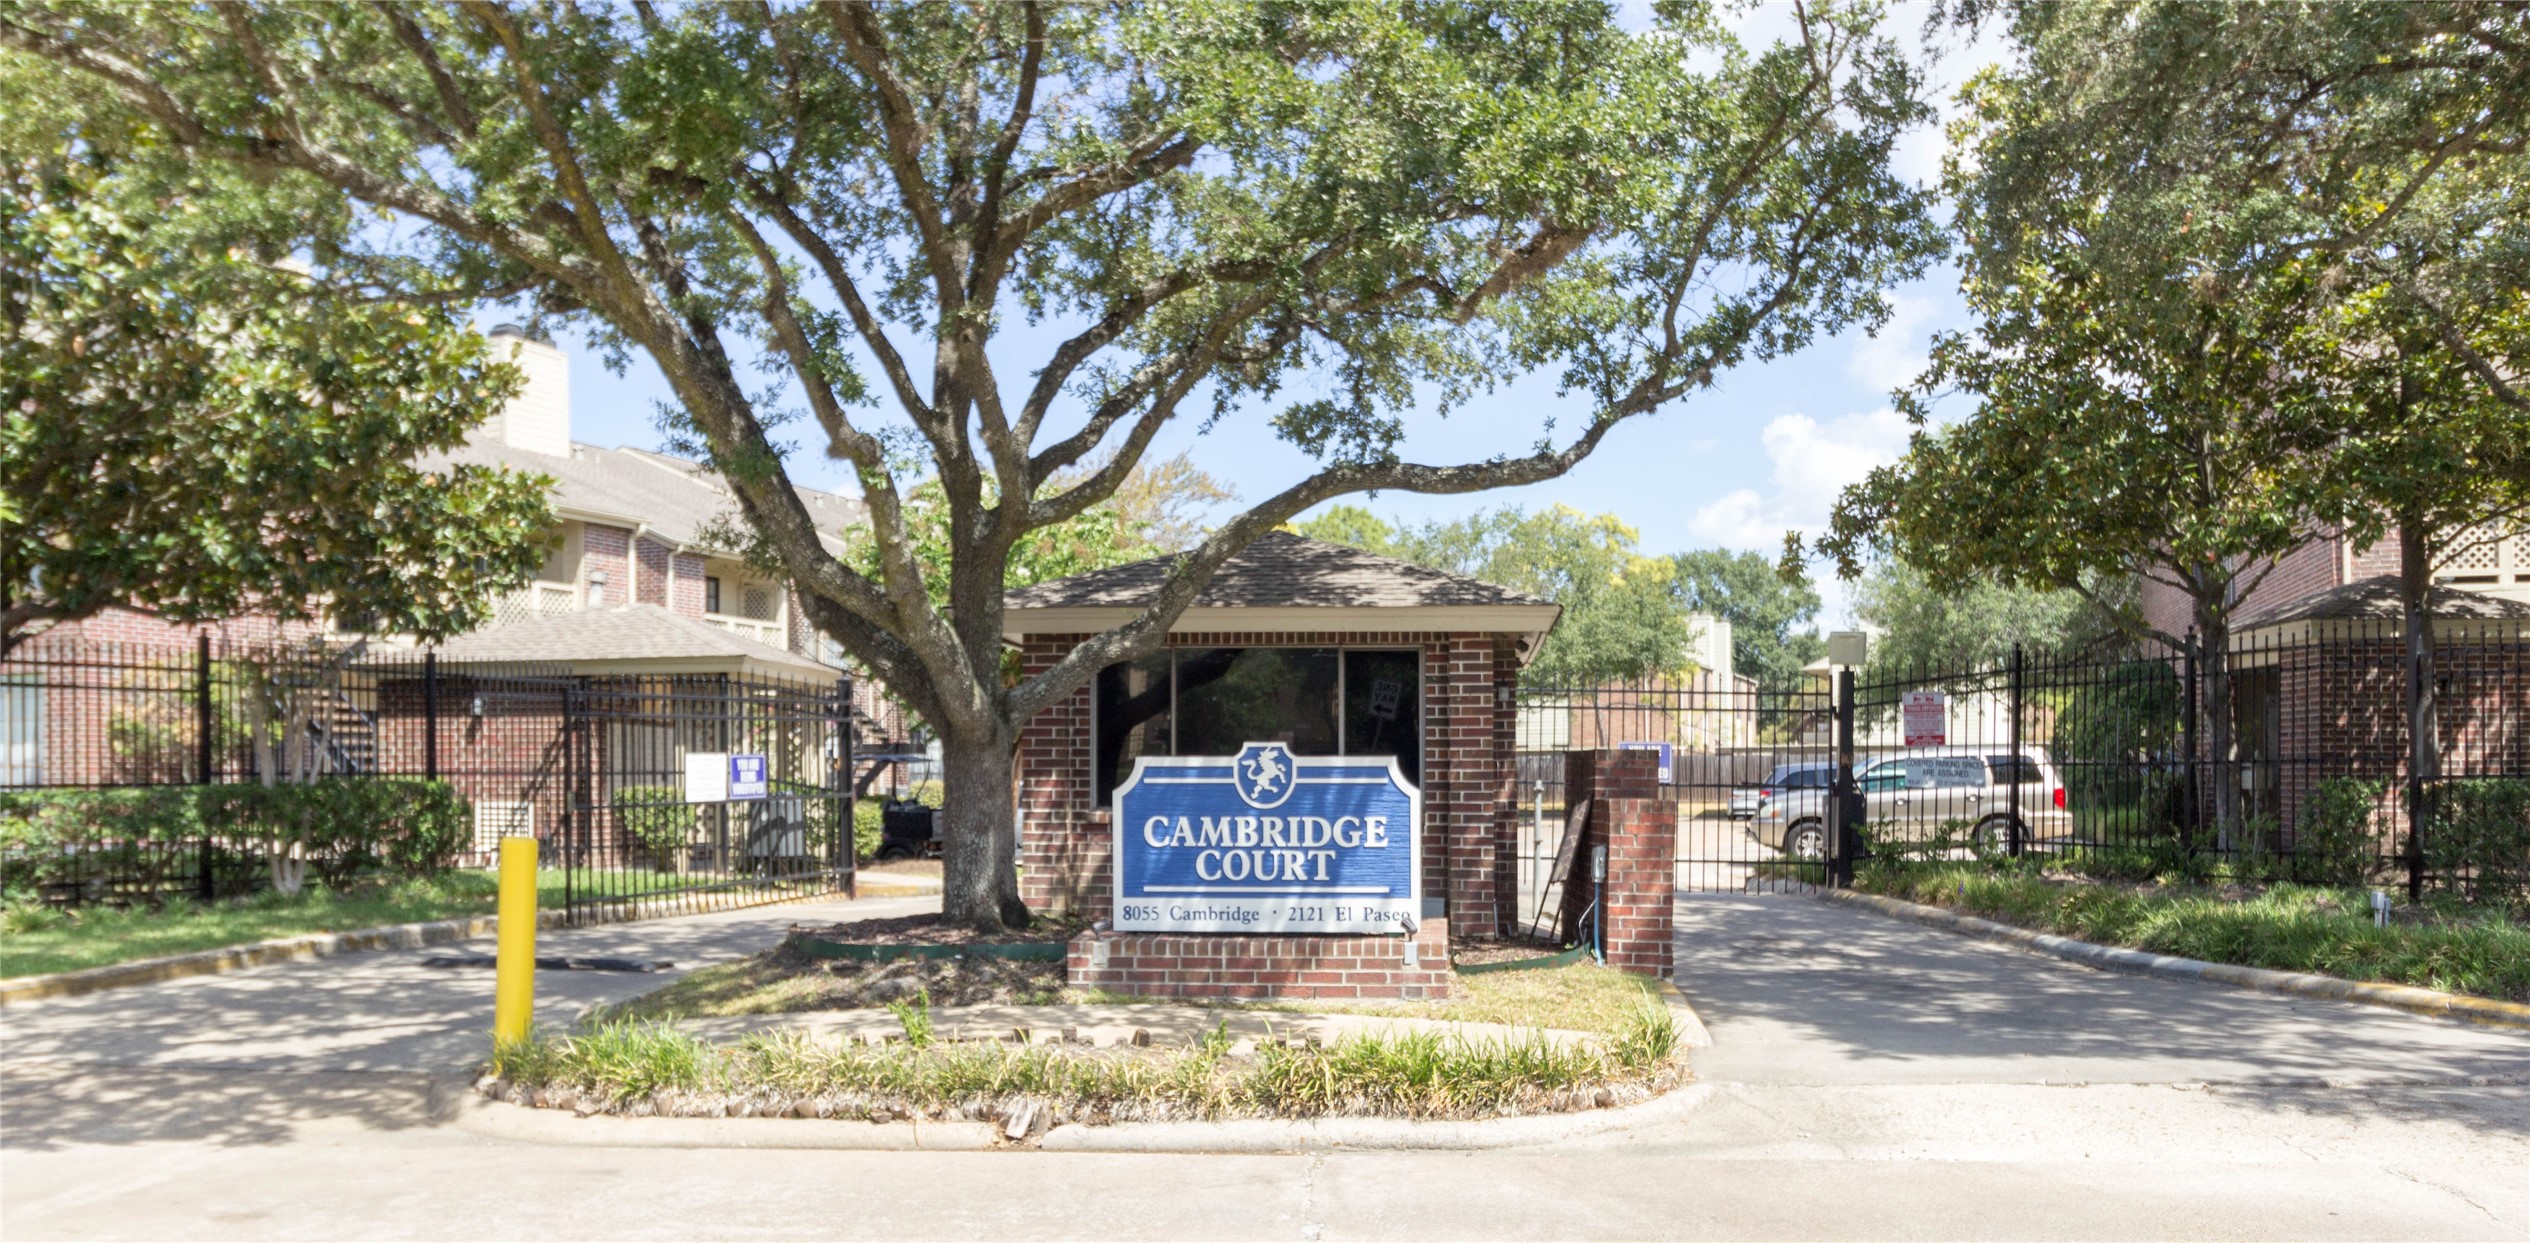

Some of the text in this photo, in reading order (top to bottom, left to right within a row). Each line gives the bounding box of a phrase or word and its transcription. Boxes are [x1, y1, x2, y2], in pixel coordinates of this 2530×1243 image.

[1906, 760, 1984, 770] COVERED PARKING SPACES
[1937, 769, 1969, 778] ASSIGNED
[1143, 815, 1389, 849] CAMBRIDGE
[1195, 849, 1336, 882] COURT
[1122, 905, 1411, 925] 8055 Cambridge 2121 El Paseo
